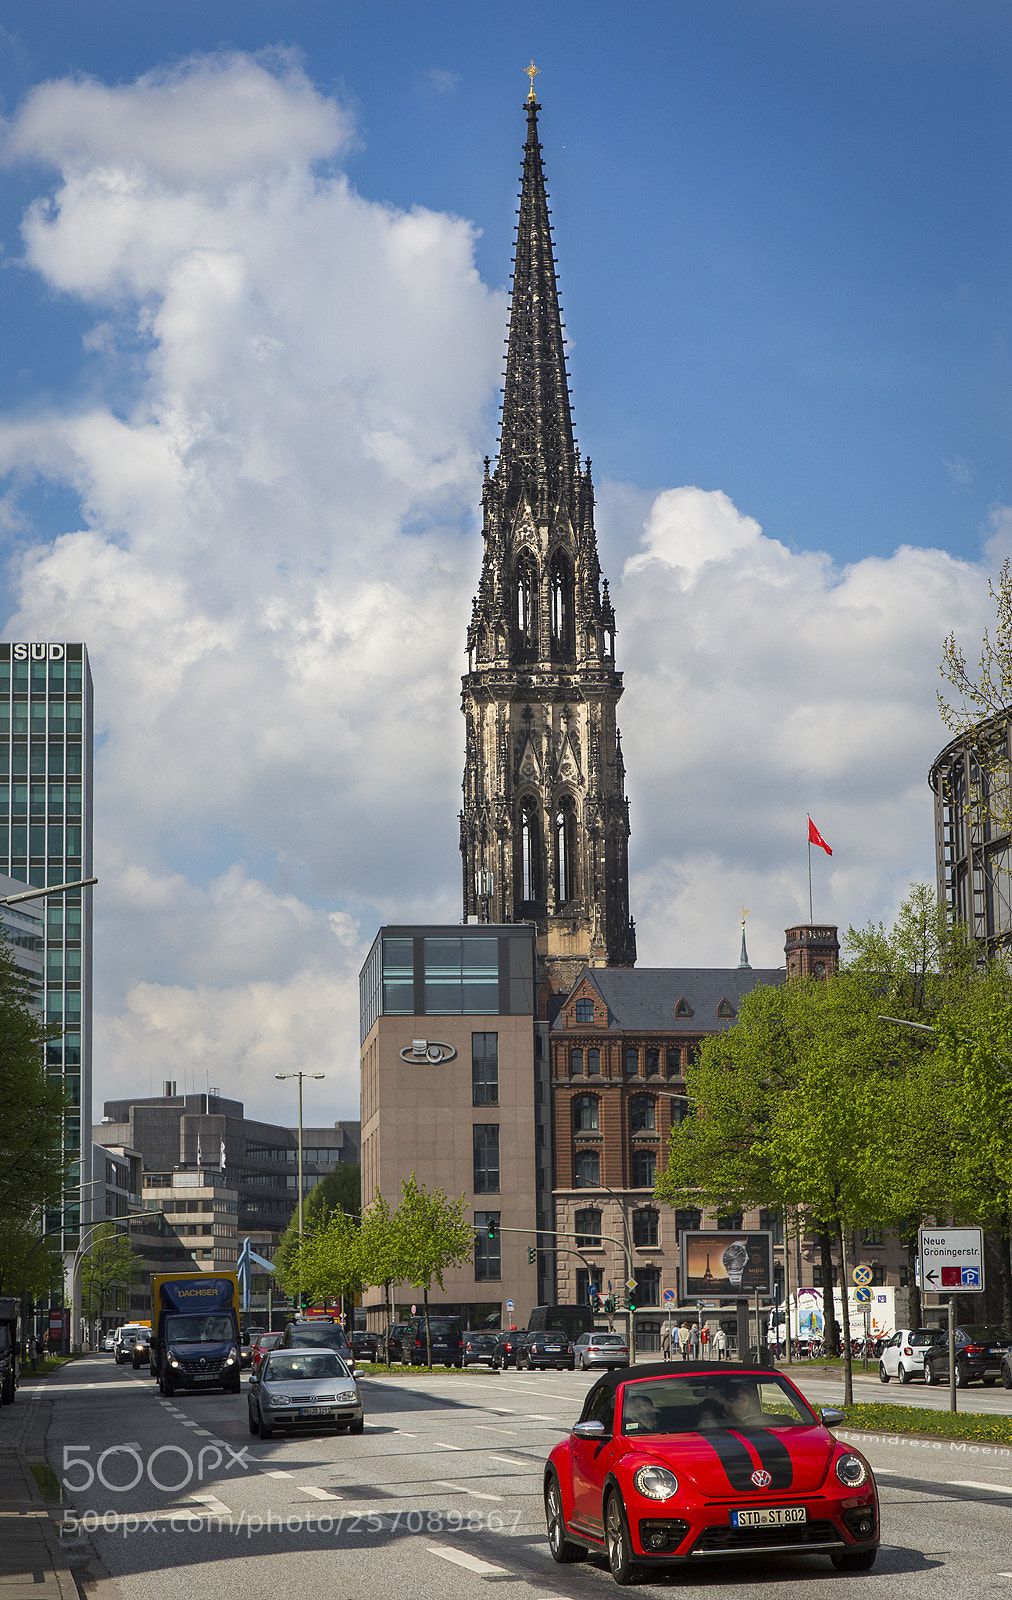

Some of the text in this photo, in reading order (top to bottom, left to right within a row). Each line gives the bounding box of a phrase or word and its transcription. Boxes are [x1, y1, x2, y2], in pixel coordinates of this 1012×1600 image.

[14, 643, 65, 661] SÜD
[923, 1237, 946, 1245] Neue
[923, 1248, 980, 1257] Gröningerstr.
[966, 1273, 975, 1284] P
[178, 1289, 218, 1298] DACHSER
[739, 1508, 805, 1525] STD ST 802
